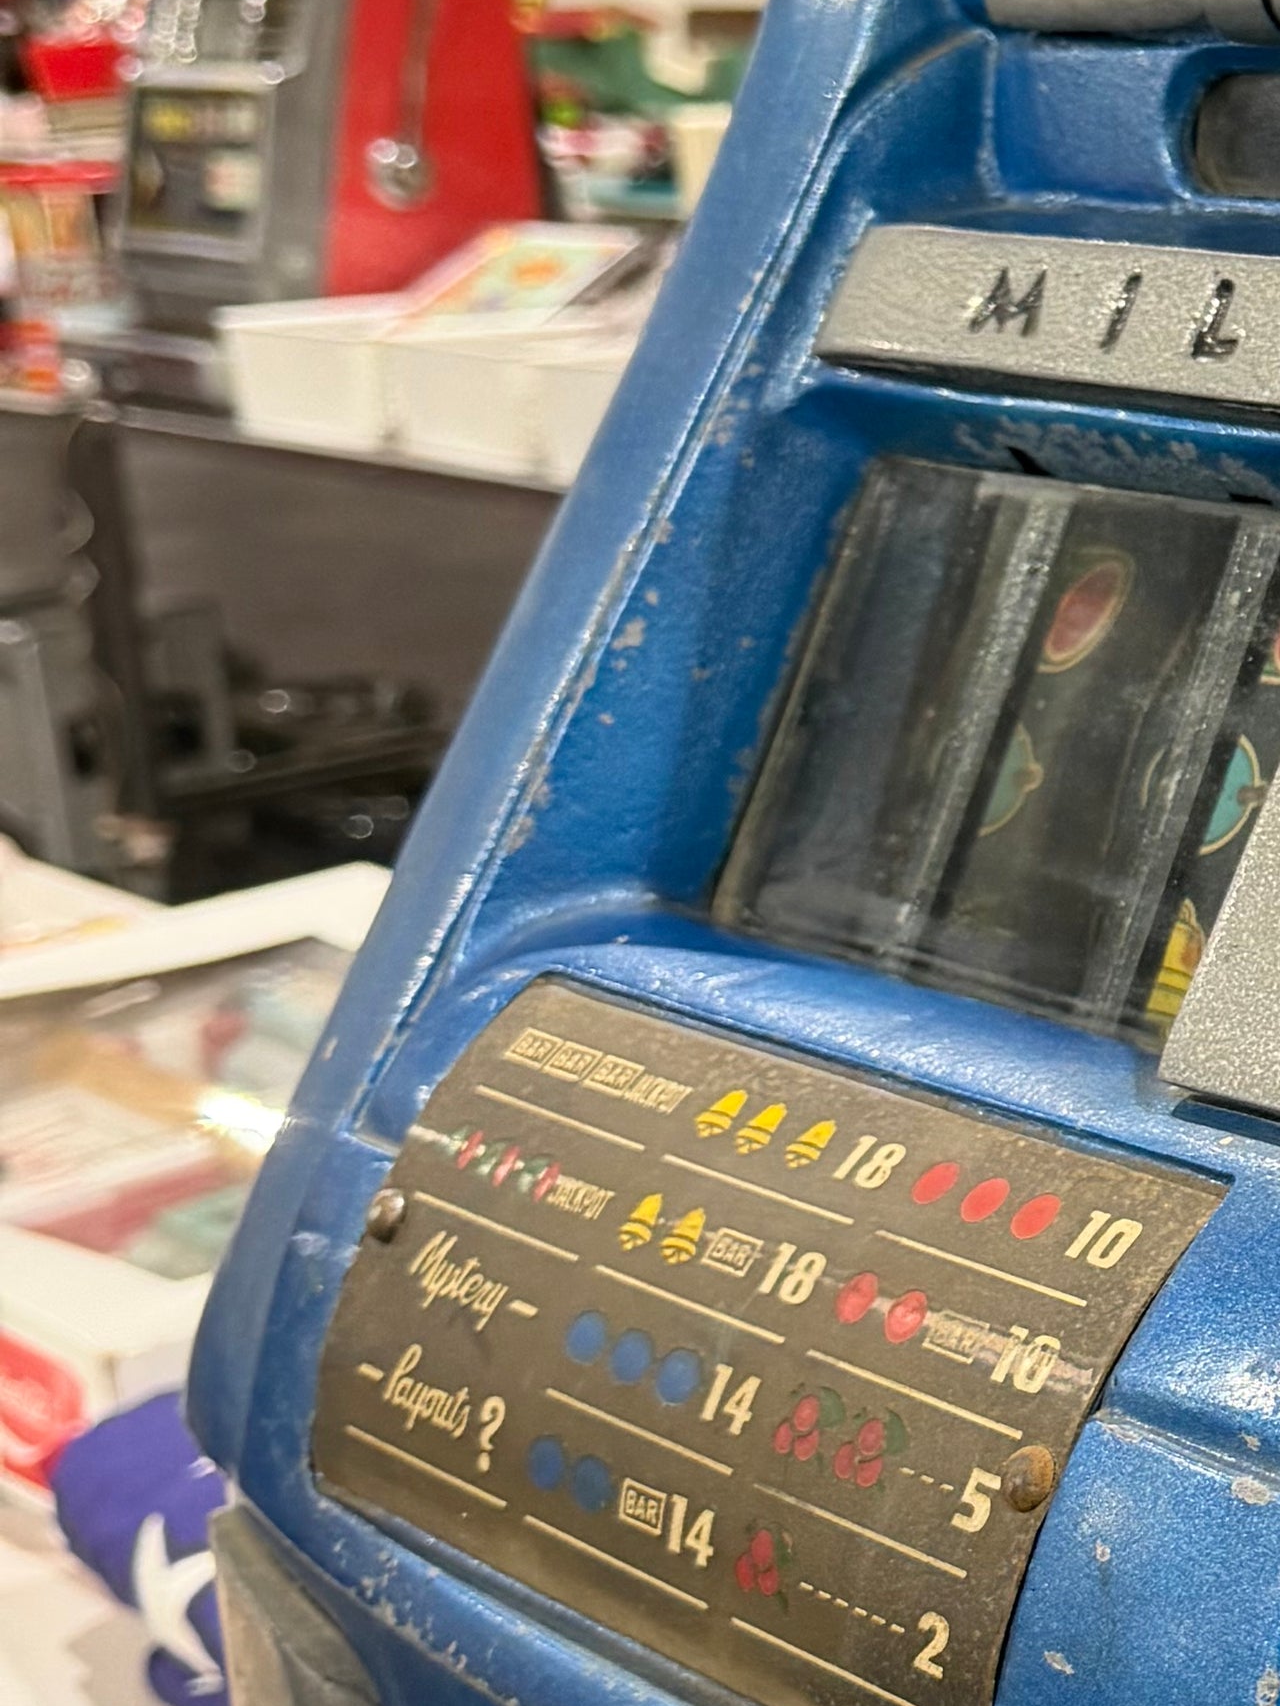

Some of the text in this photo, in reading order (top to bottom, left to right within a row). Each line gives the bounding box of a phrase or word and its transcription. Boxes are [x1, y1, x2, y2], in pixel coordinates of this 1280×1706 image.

[832, 1134, 907, 1190] 18
[1064, 1209, 1144, 1269] 10
[409, 1230, 509, 1332] Mystery
[547, 1174, 616, 1221] JACKPOT
[709, 1236, 754, 1270] BAR
[759, 1242, 827, 1306] 18
[991, 1325, 1061, 1394] 10
[383, 1343, 506, 1473] Payouts ?
[701, 1363, 1002, 1533] 14 5
[624, 1488, 951, 1680] BAR 14 2
